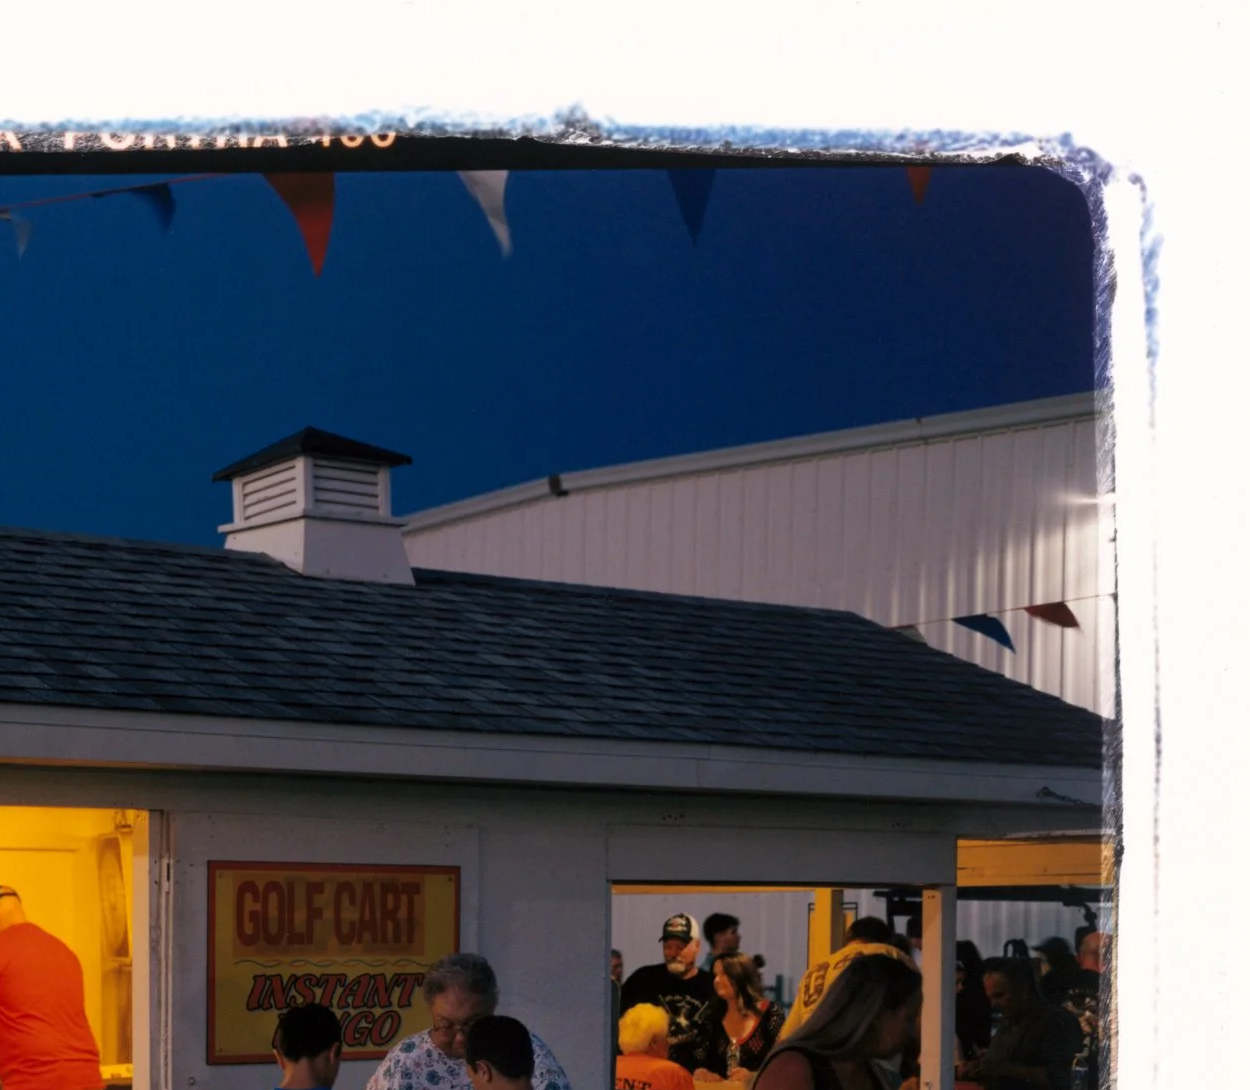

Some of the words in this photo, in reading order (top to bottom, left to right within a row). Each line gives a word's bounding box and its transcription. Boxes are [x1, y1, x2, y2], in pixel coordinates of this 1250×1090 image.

[235, 880, 326, 947] GOLF
[333, 880, 423, 946] CART
[246, 972, 426, 1011] INSTANT
